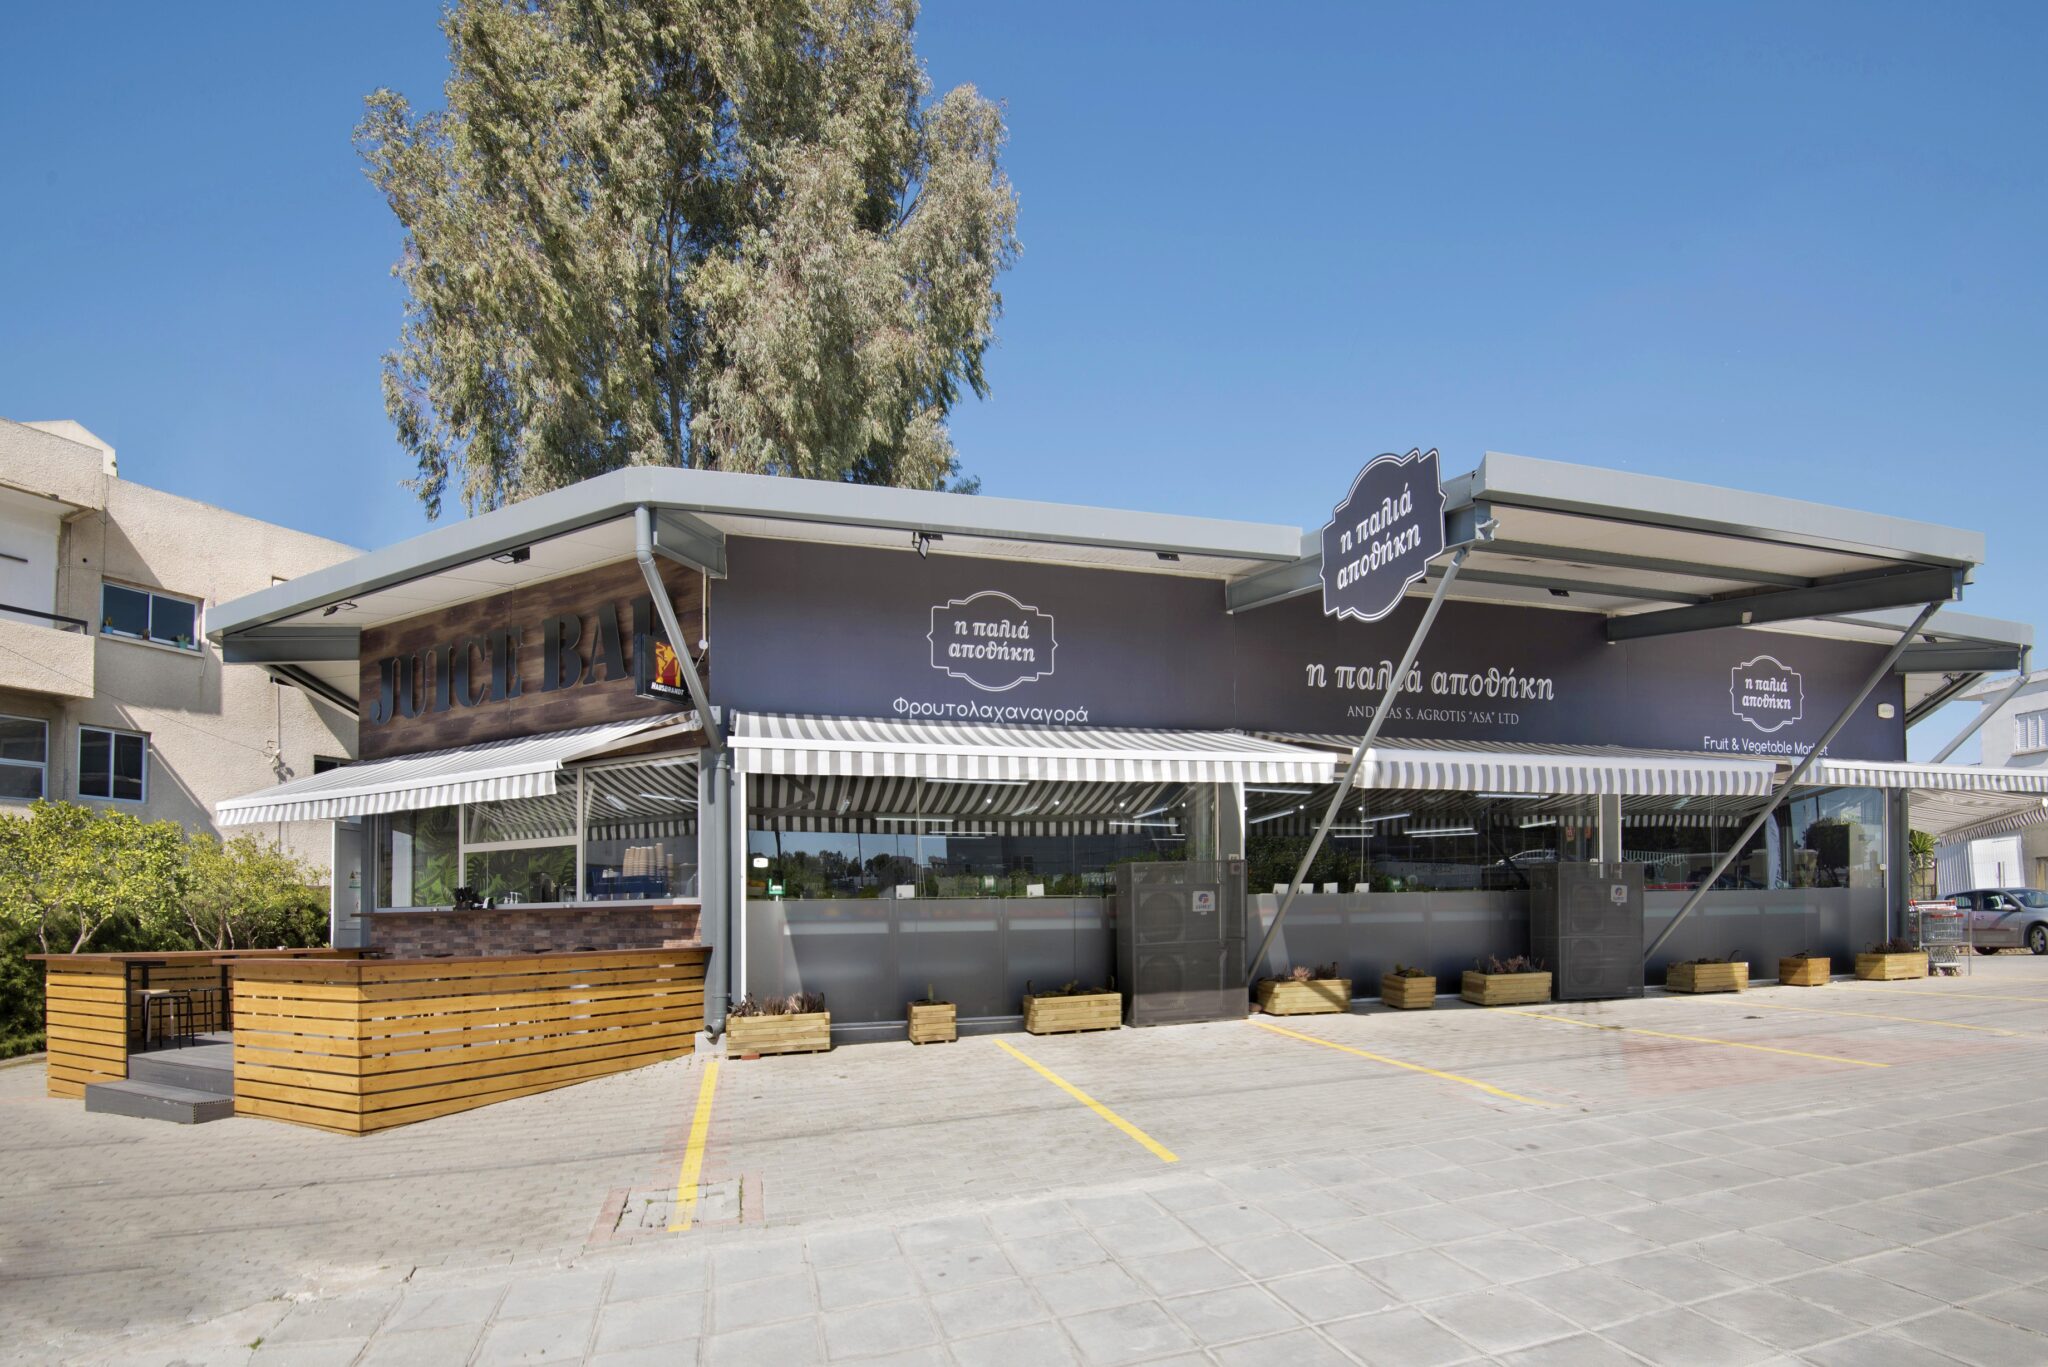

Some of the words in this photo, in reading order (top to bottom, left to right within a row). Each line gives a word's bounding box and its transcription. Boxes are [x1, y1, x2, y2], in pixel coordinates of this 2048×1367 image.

[1340, 530, 1353, 554] η
[1356, 482, 1413, 544] παλιά
[1336, 524, 1422, 590] αποθήκη
[954, 620, 968, 635] η
[972, 619, 1031, 640] παλιά
[948, 641, 1036, 662] αποθήκη
[369, 625, 522, 725] JUICE
[1305, 663, 1328, 688] η
[1334, 660, 1424, 693] παλά
[1430, 667, 1555, 700] αποθήκη
[1744, 678, 1753, 689] η
[1755, 677, 1788, 692] παλιά
[893, 697, 1089, 724] Φρουτολαχαναγορά
[1742, 694, 1791, 709] αποθήκη
[1347, 705, 1402, 719] ANDAS
[1405, 707, 1414, 720] S.
[1416, 708, 1467, 723] AGROTIS
[1498, 712, 1520, 725] LTD
[1703, 736, 1729, 751] Fruit
[1731, 737, 1740, 751] &
[1741, 738, 1793, 755] Vegetable
